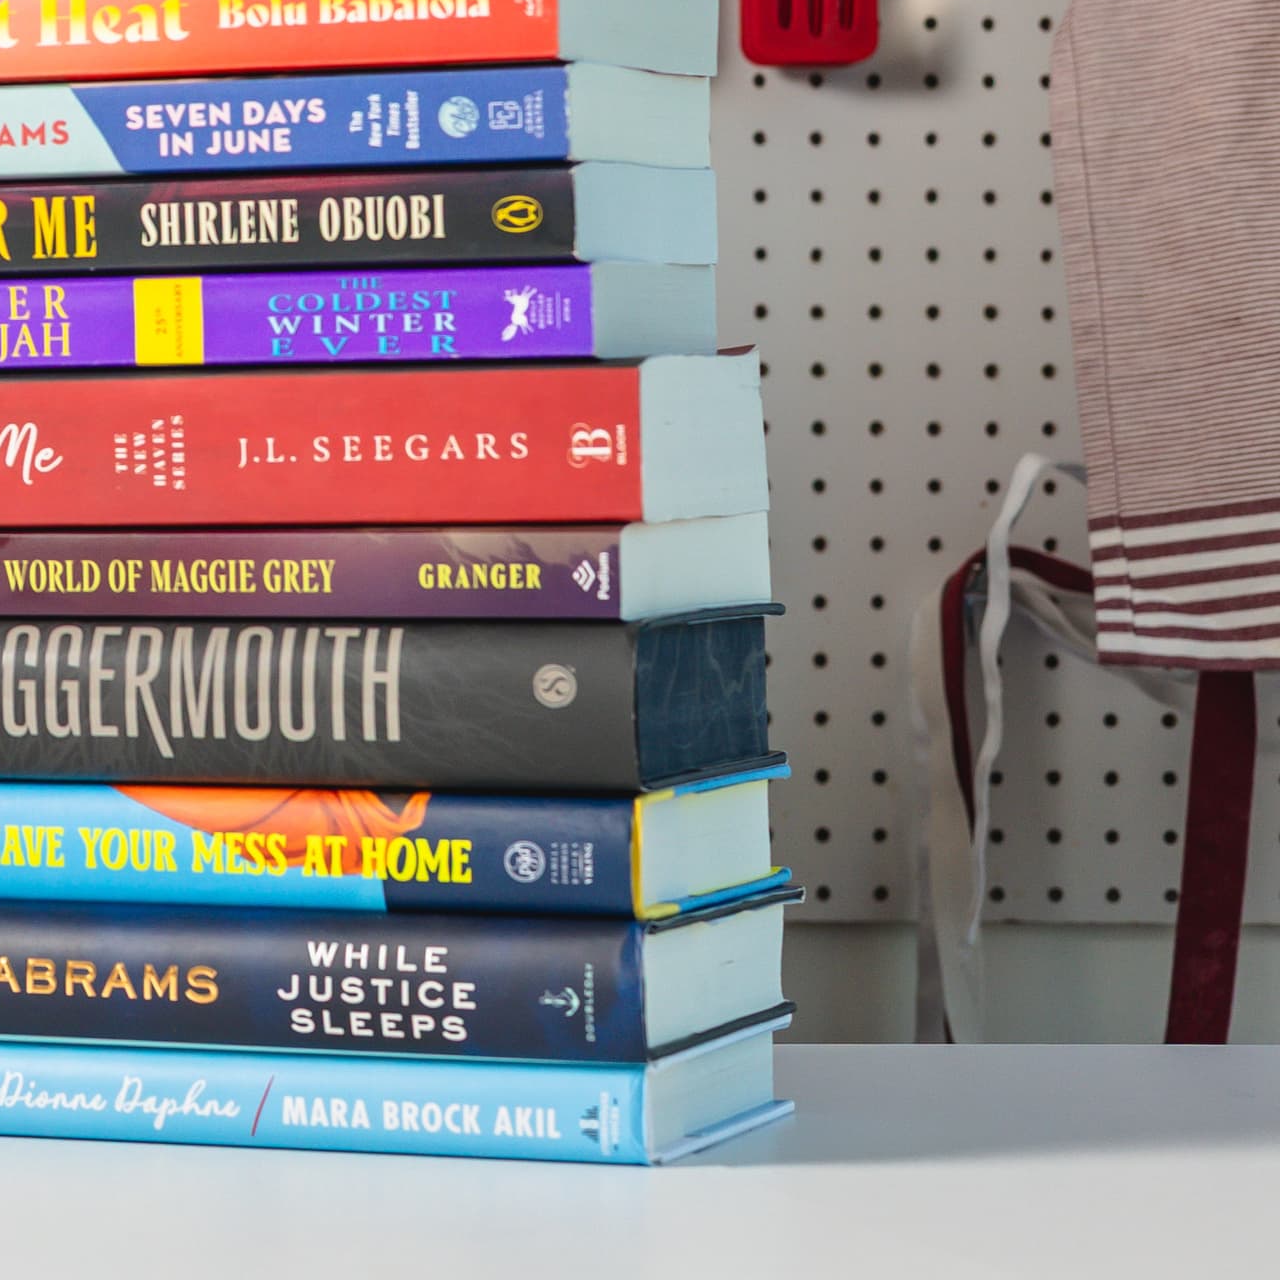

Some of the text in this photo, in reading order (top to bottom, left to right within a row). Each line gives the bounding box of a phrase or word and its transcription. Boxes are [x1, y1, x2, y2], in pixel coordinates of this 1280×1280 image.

[125, 97, 327, 132] SEVEN DAYS
[349, 110, 365, 133] The
[368, 93, 384, 148] New York
[387, 102, 402, 137] Times
[404, 89, 420, 150] Bestseller
[159, 127, 293, 157] IN JUNE
[31, 194, 97, 259] ME
[140, 198, 299, 247] SHIRLENE
[318, 193, 447, 242] OBUOBI
[340, 277, 383, 289] THE
[268, 290, 458, 314] COLDEST
[268, 313, 457, 334] WINTER
[268, 335, 458, 357] EVER
[114, 432, 129, 473] THE
[133, 430, 148, 475] NEW
[152, 418, 165, 488] HAVEN
[171, 414, 186, 490] SERIES
[237, 430, 531, 469] J.L. SEEGARS
[2, 558, 100, 594] WORLD
[107, 558, 141, 594] OF
[149, 558, 257, 594] MAGGIE
[263, 558, 336, 594] GREY
[418, 562, 542, 591] GRANGER
[596, 551, 611, 601] Podium
[77, 826, 177, 872] YOUR
[191, 831, 287, 876] MESS
[303, 835, 349, 878] AT
[363, 836, 473, 884] HOME
[308, 941, 449, 975] WHILE
[277, 975, 477, 1011] JUSTICE
[290, 1008, 469, 1043] SLEEPS
[115, 1077, 241, 1130] Daphne
[282, 1096, 370, 1130] MARA
[382, 1098, 484, 1136] BROCK
[493, 1104, 564, 1140] AKIL
